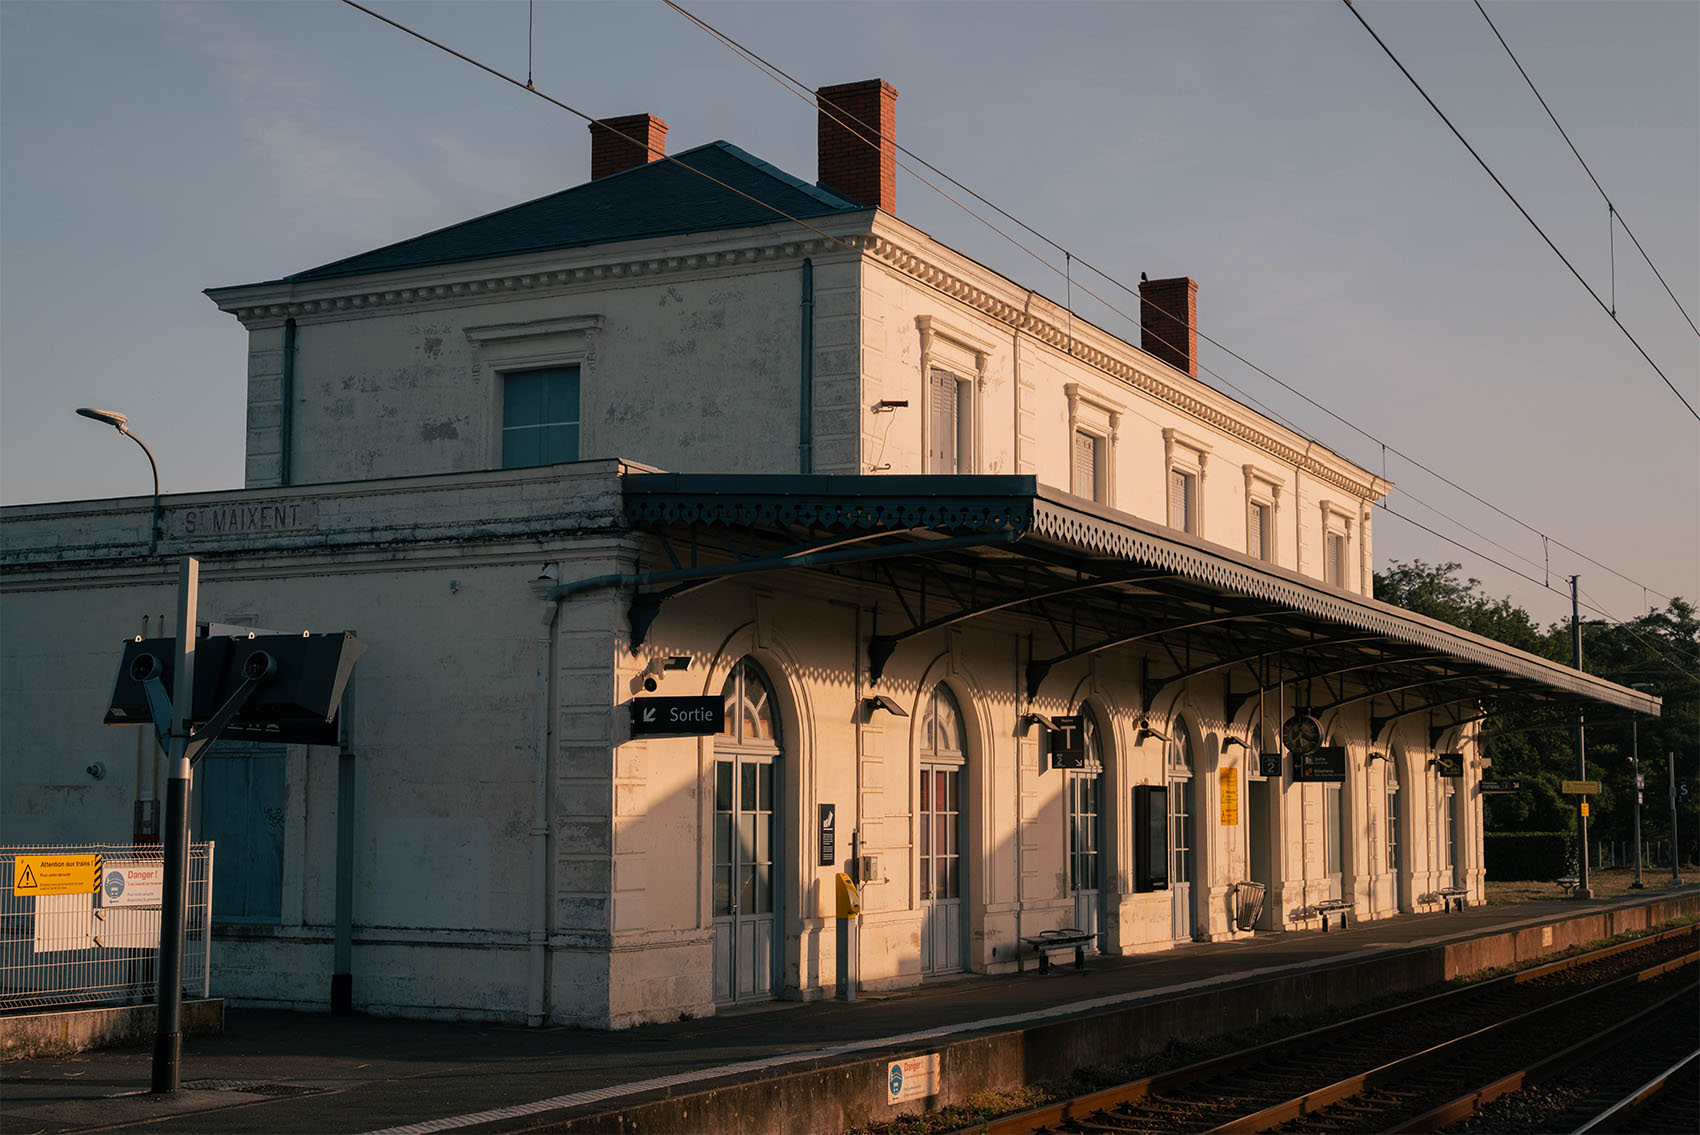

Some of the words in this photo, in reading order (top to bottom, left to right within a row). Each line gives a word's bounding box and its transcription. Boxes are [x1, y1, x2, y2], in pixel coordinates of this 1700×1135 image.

[670, 707, 713, 721] Sortie
[1060, 725, 1076, 749] T
[1057, 757, 1063, 766] 2
[1267, 762, 1275, 772] 2
[1680, 784, 1689, 795] S
[128, 870, 154, 880] Danger
[904, 1062, 921, 1072] Danger
